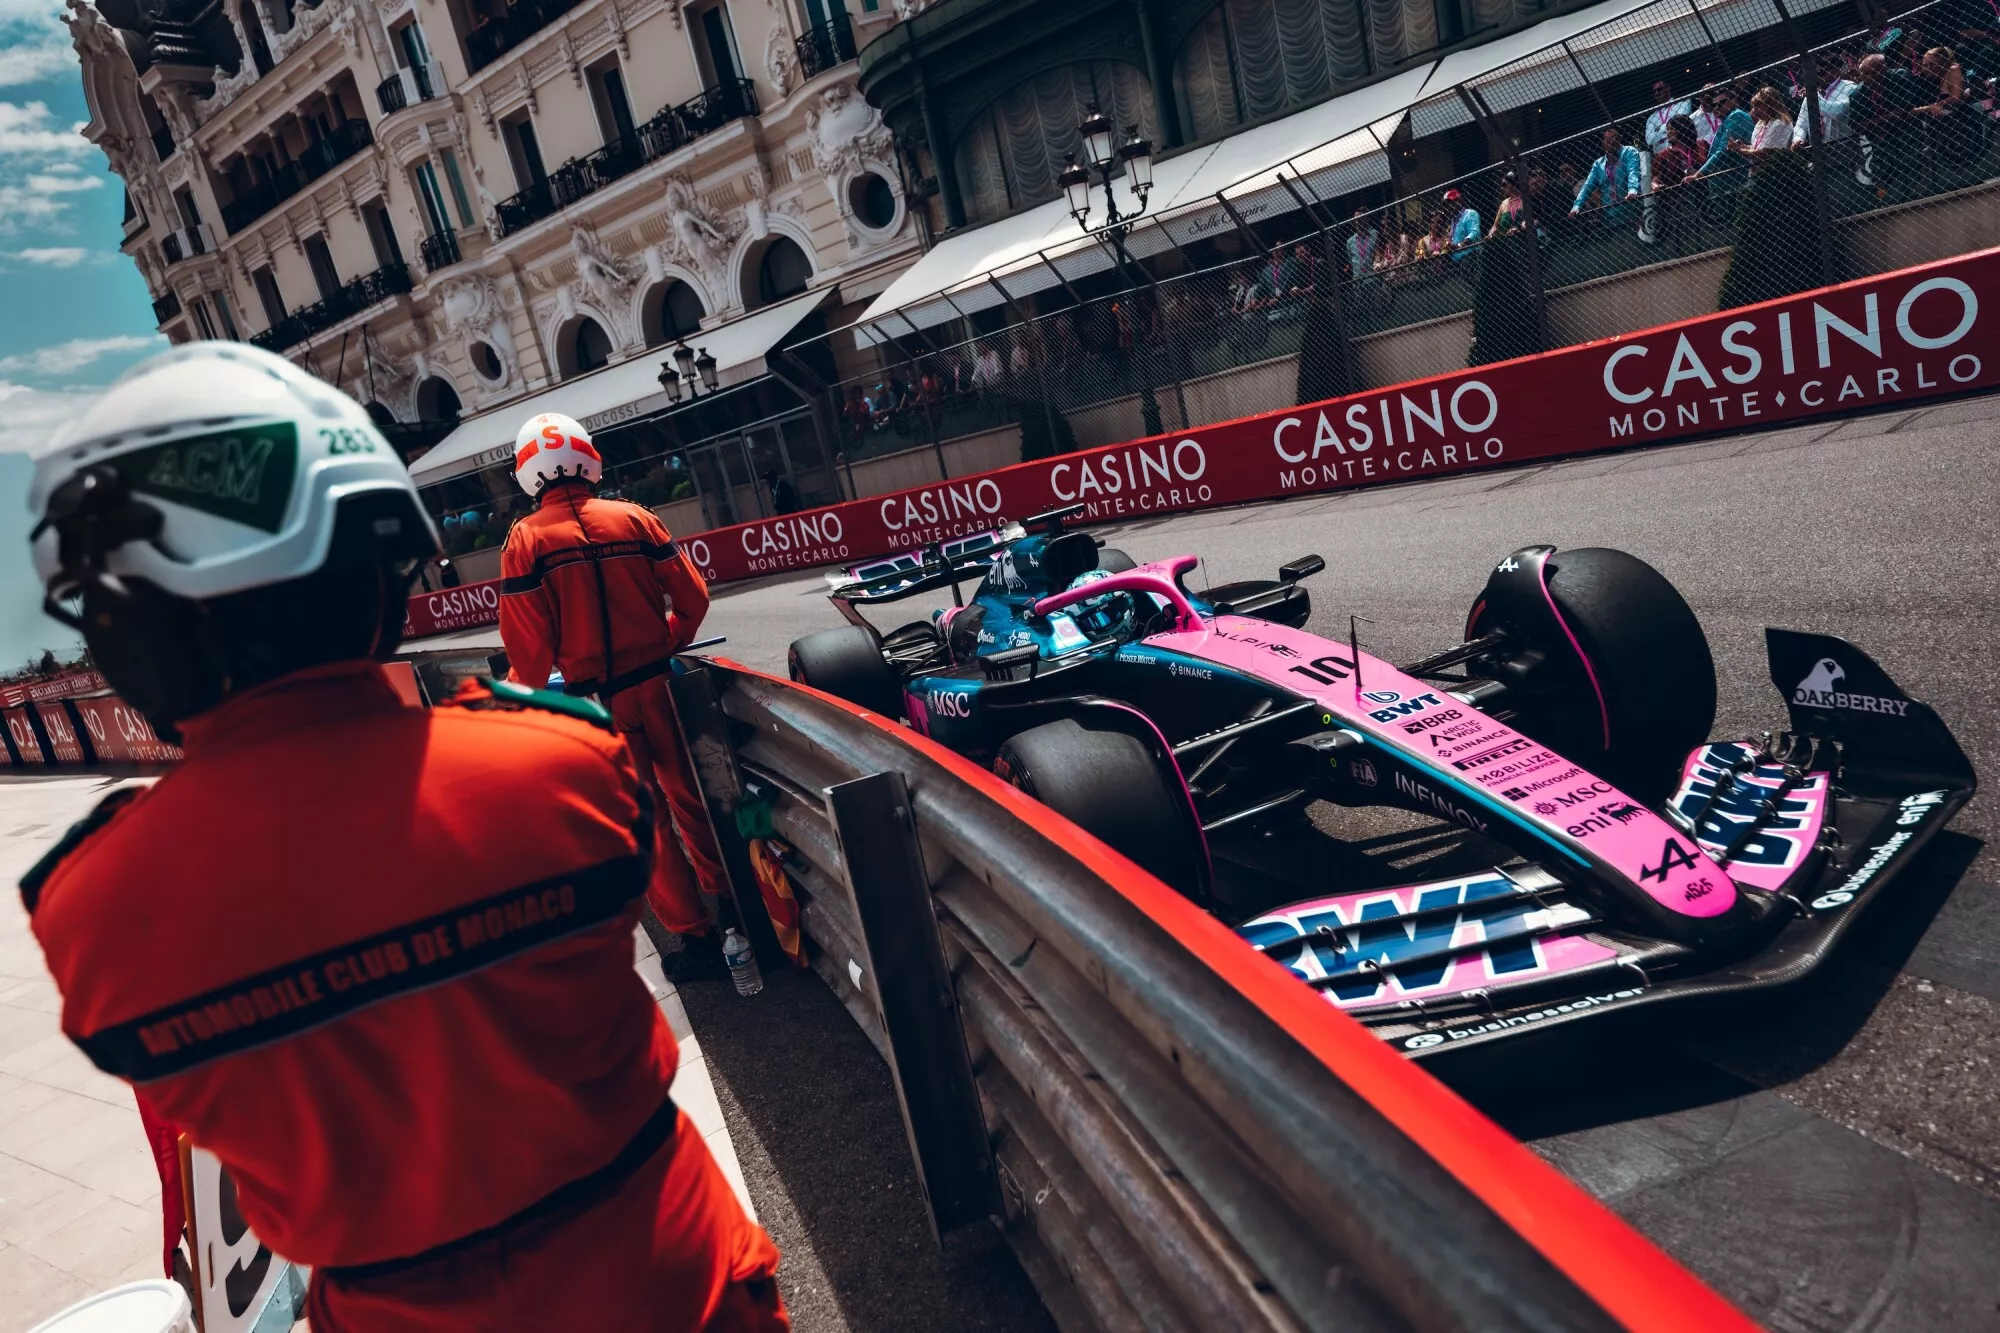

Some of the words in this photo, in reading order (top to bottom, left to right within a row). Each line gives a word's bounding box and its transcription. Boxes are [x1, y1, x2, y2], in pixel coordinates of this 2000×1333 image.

[1602, 276, 1980, 404] CASINO
[1609, 391, 1762, 439] MONTE
[1800, 354, 1982, 408] CARLO
[491, 444, 515, 460] LOUI
[586, 404, 642, 431] DUCASSE
[1273, 380, 1498, 464] CASINO
[318, 428, 376, 455] 283
[541, 425, 565, 450] S
[146, 436, 274, 504] ACM
[1050, 439, 1206, 502] CASINO
[1280, 459, 1376, 489] MONTE
[1398, 437, 1504, 472] CARLO
[881, 478, 1001, 530] CASINO
[1060, 498, 1126, 522] NTE
[1140, 484, 1212, 508] CARLO
[741, 512, 843, 557] CASINO
[888, 529, 943, 549] MONTE
[748, 555, 794, 572] MONTE
[802, 545, 849, 562] CARLO
[429, 585, 498, 618] CASINO
[434, 616, 467, 629] MONTE
[1214, 628, 1299, 657] ALPINE
[1177, 665, 1212, 680] BINANCE
[1287, 655, 1355, 686] 10
[933, 690, 970, 718] MSC
[1367, 692, 1443, 724] BWT
[1792, 688, 1909, 716] OAKBERRY
[114, 706, 157, 743] CASI
[1421, 709, 1463, 730] BRB
[1442, 720, 1480, 735] ARCTIC
[1454, 726, 1483, 739] WOLF
[1451, 738, 1534, 771] PIRELLI
[1453, 729, 1511, 752] BINANCE
[1486, 771, 1526, 788] FINANCIAL
[1526, 758, 1561, 773] SERVICES
[1524, 767, 1585, 792] Microsoft
[1553, 781, 1613, 808] MSC
[1566, 811, 1613, 838] eni
[323, 940, 410, 993] CLUB
[410, 922, 455, 966] DE
[456, 884, 577, 951] MONACO
[1447, 985, 1646, 1043] businessolver
